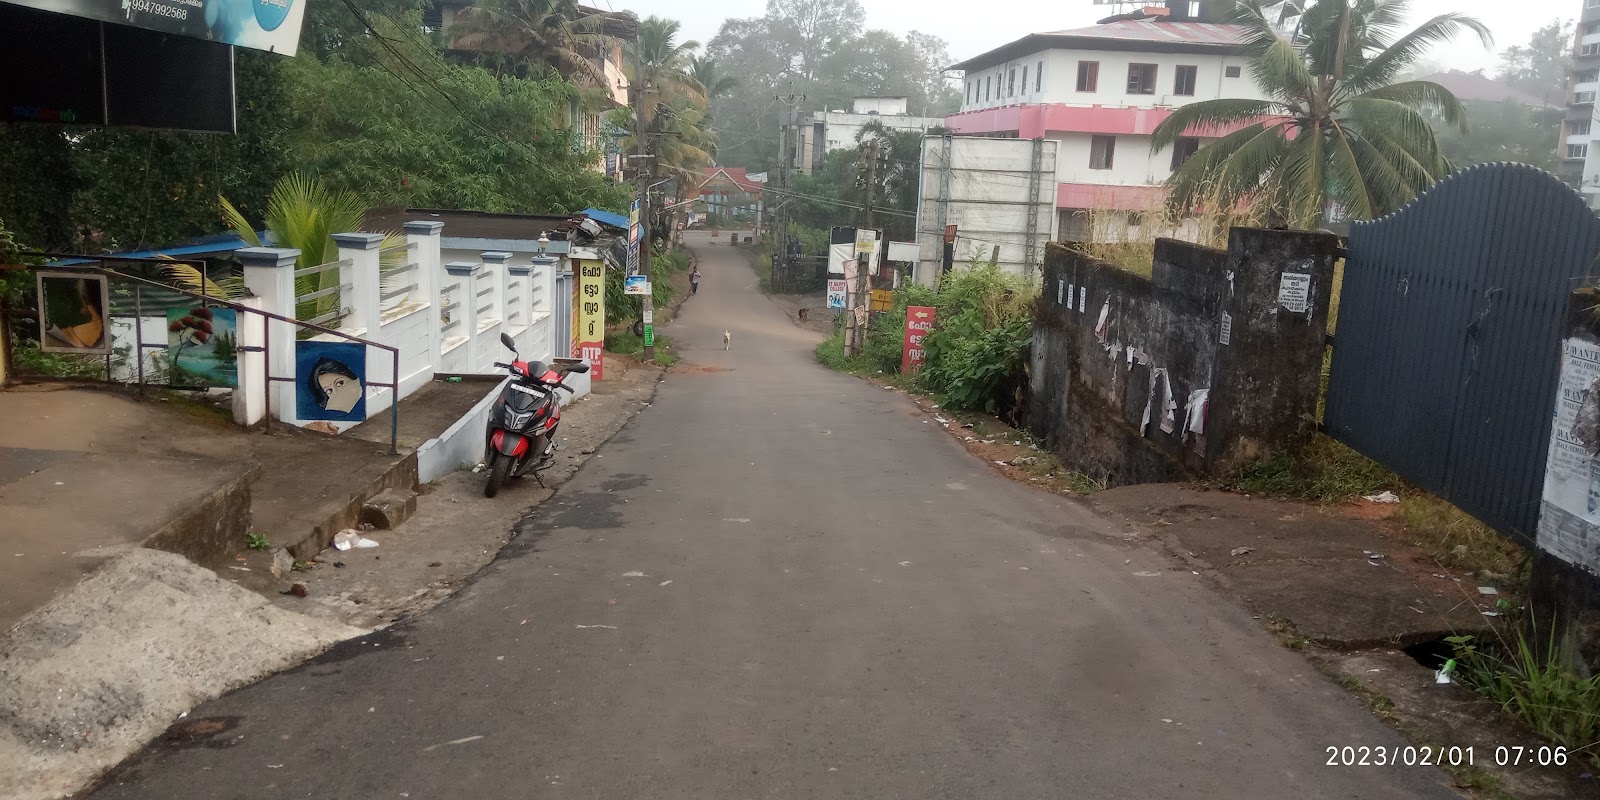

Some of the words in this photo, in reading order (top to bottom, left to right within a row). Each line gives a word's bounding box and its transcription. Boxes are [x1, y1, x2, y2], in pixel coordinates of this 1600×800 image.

[131, 0, 188, 20] 9947992568
[582, 346, 601, 360] DTP
[1570, 345, 1600, 362] WANTE
